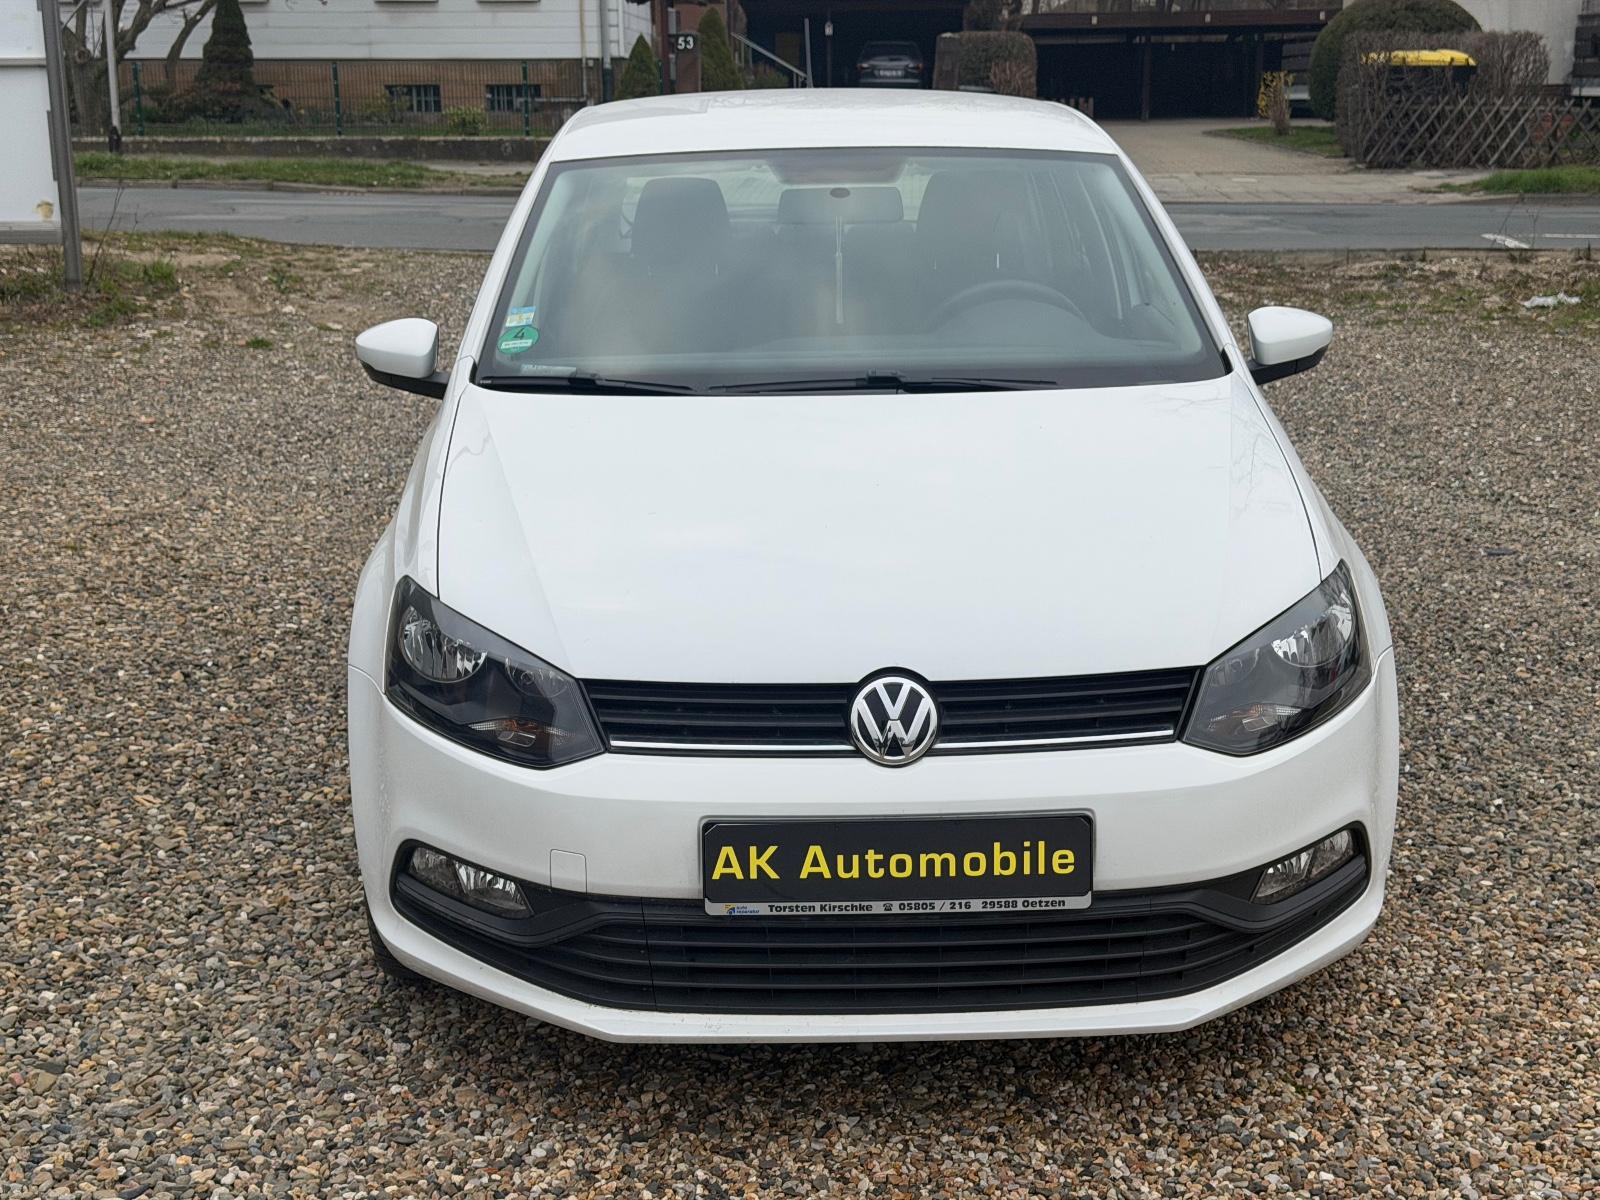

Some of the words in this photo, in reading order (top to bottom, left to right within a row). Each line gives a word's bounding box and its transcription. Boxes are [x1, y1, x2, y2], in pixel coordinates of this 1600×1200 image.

[677, 36, 694, 50] 53
[512, 327, 525, 340] 4
[853, 678, 934, 760] VW
[711, 845, 781, 880] AK
[799, 840, 1075, 879] Automobile
[767, 904, 816, 913] Torsten
[819, 903, 873, 912] Kirschke
[898, 902, 936, 911] 05805
[949, 901, 972, 910] 216
[981, 900, 1018, 909] 29588
[1021, 899, 1066, 908] Oetzen
